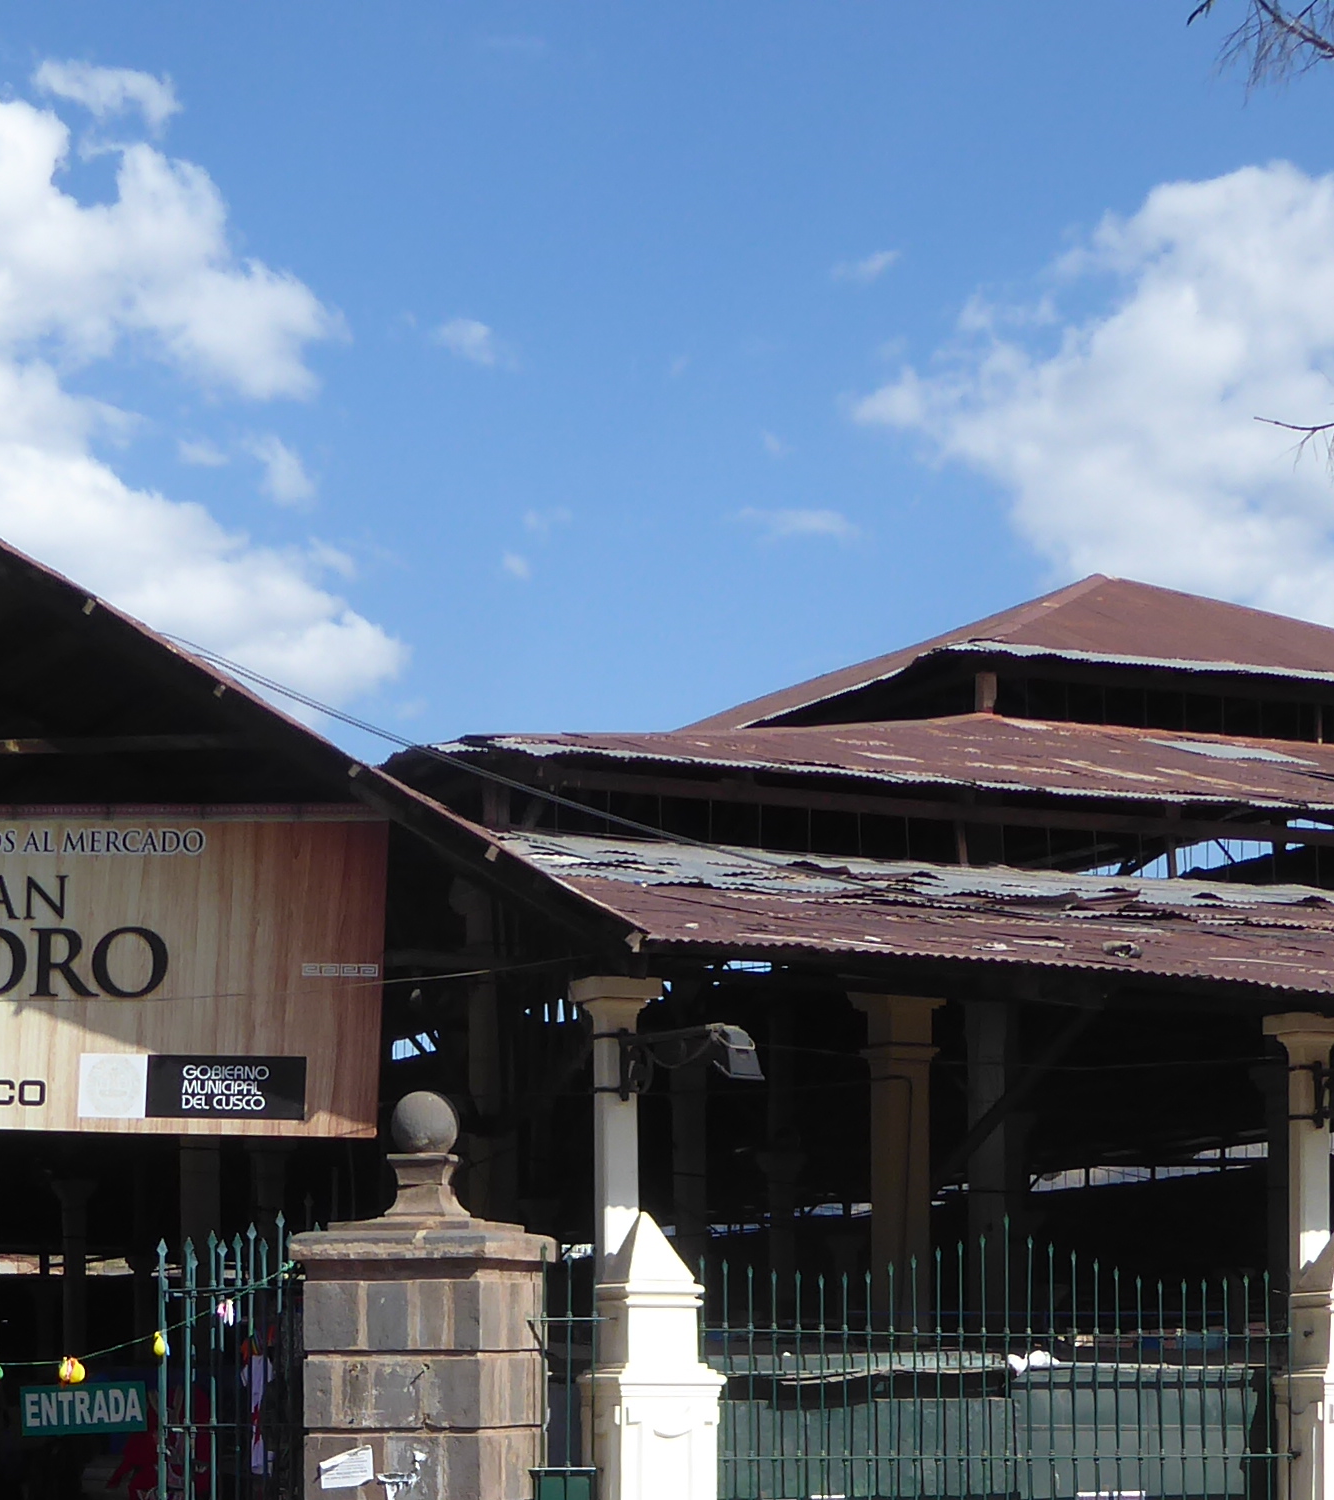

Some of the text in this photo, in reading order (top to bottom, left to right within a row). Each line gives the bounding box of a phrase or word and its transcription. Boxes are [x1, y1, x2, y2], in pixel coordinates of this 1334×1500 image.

[25, 830, 56, 853] AL
[64, 830, 205, 853] MERCADO
[182, 1064, 270, 1080] GOBIERNO
[182, 1080, 263, 1095] MUNICIPAL
[181, 1095, 266, 1111] DEL CUSCO
[25, 1388, 143, 1427] ENTRADA
